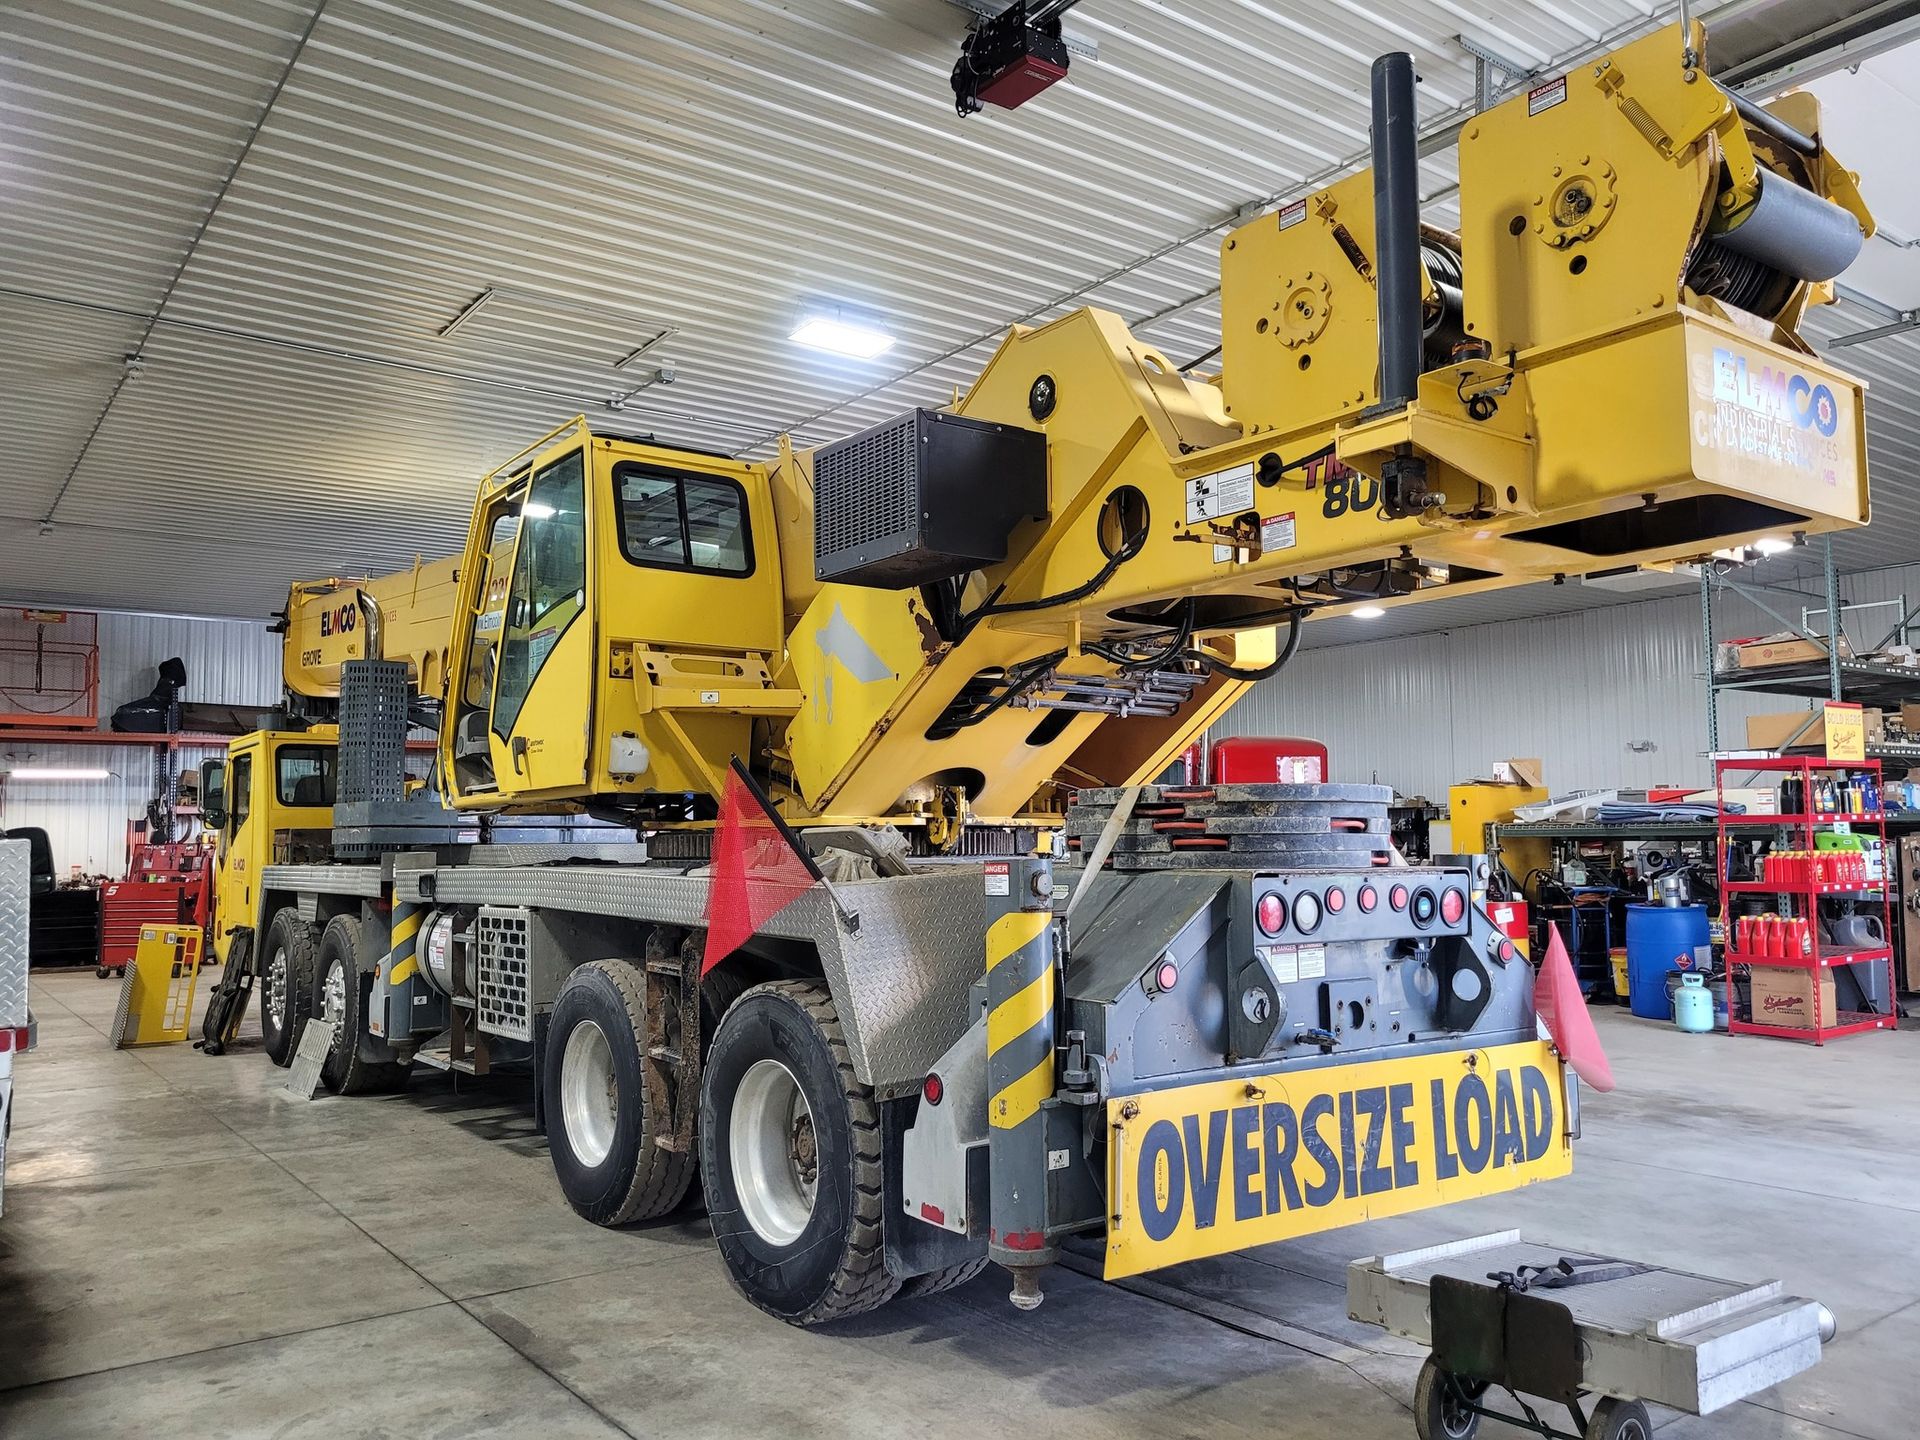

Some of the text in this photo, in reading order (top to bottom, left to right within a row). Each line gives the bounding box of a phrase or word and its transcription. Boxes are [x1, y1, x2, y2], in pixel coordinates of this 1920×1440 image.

[1536, 78, 1565, 95] DANGER
[1713, 348, 1837, 437] ELMCO
[321, 602, 356, 638] ELMCO
[302, 648, 321, 667] GROVE
[985, 865, 1008, 873] ANGER
[1137, 1065, 1553, 1242] OVERSIZE LOAD
